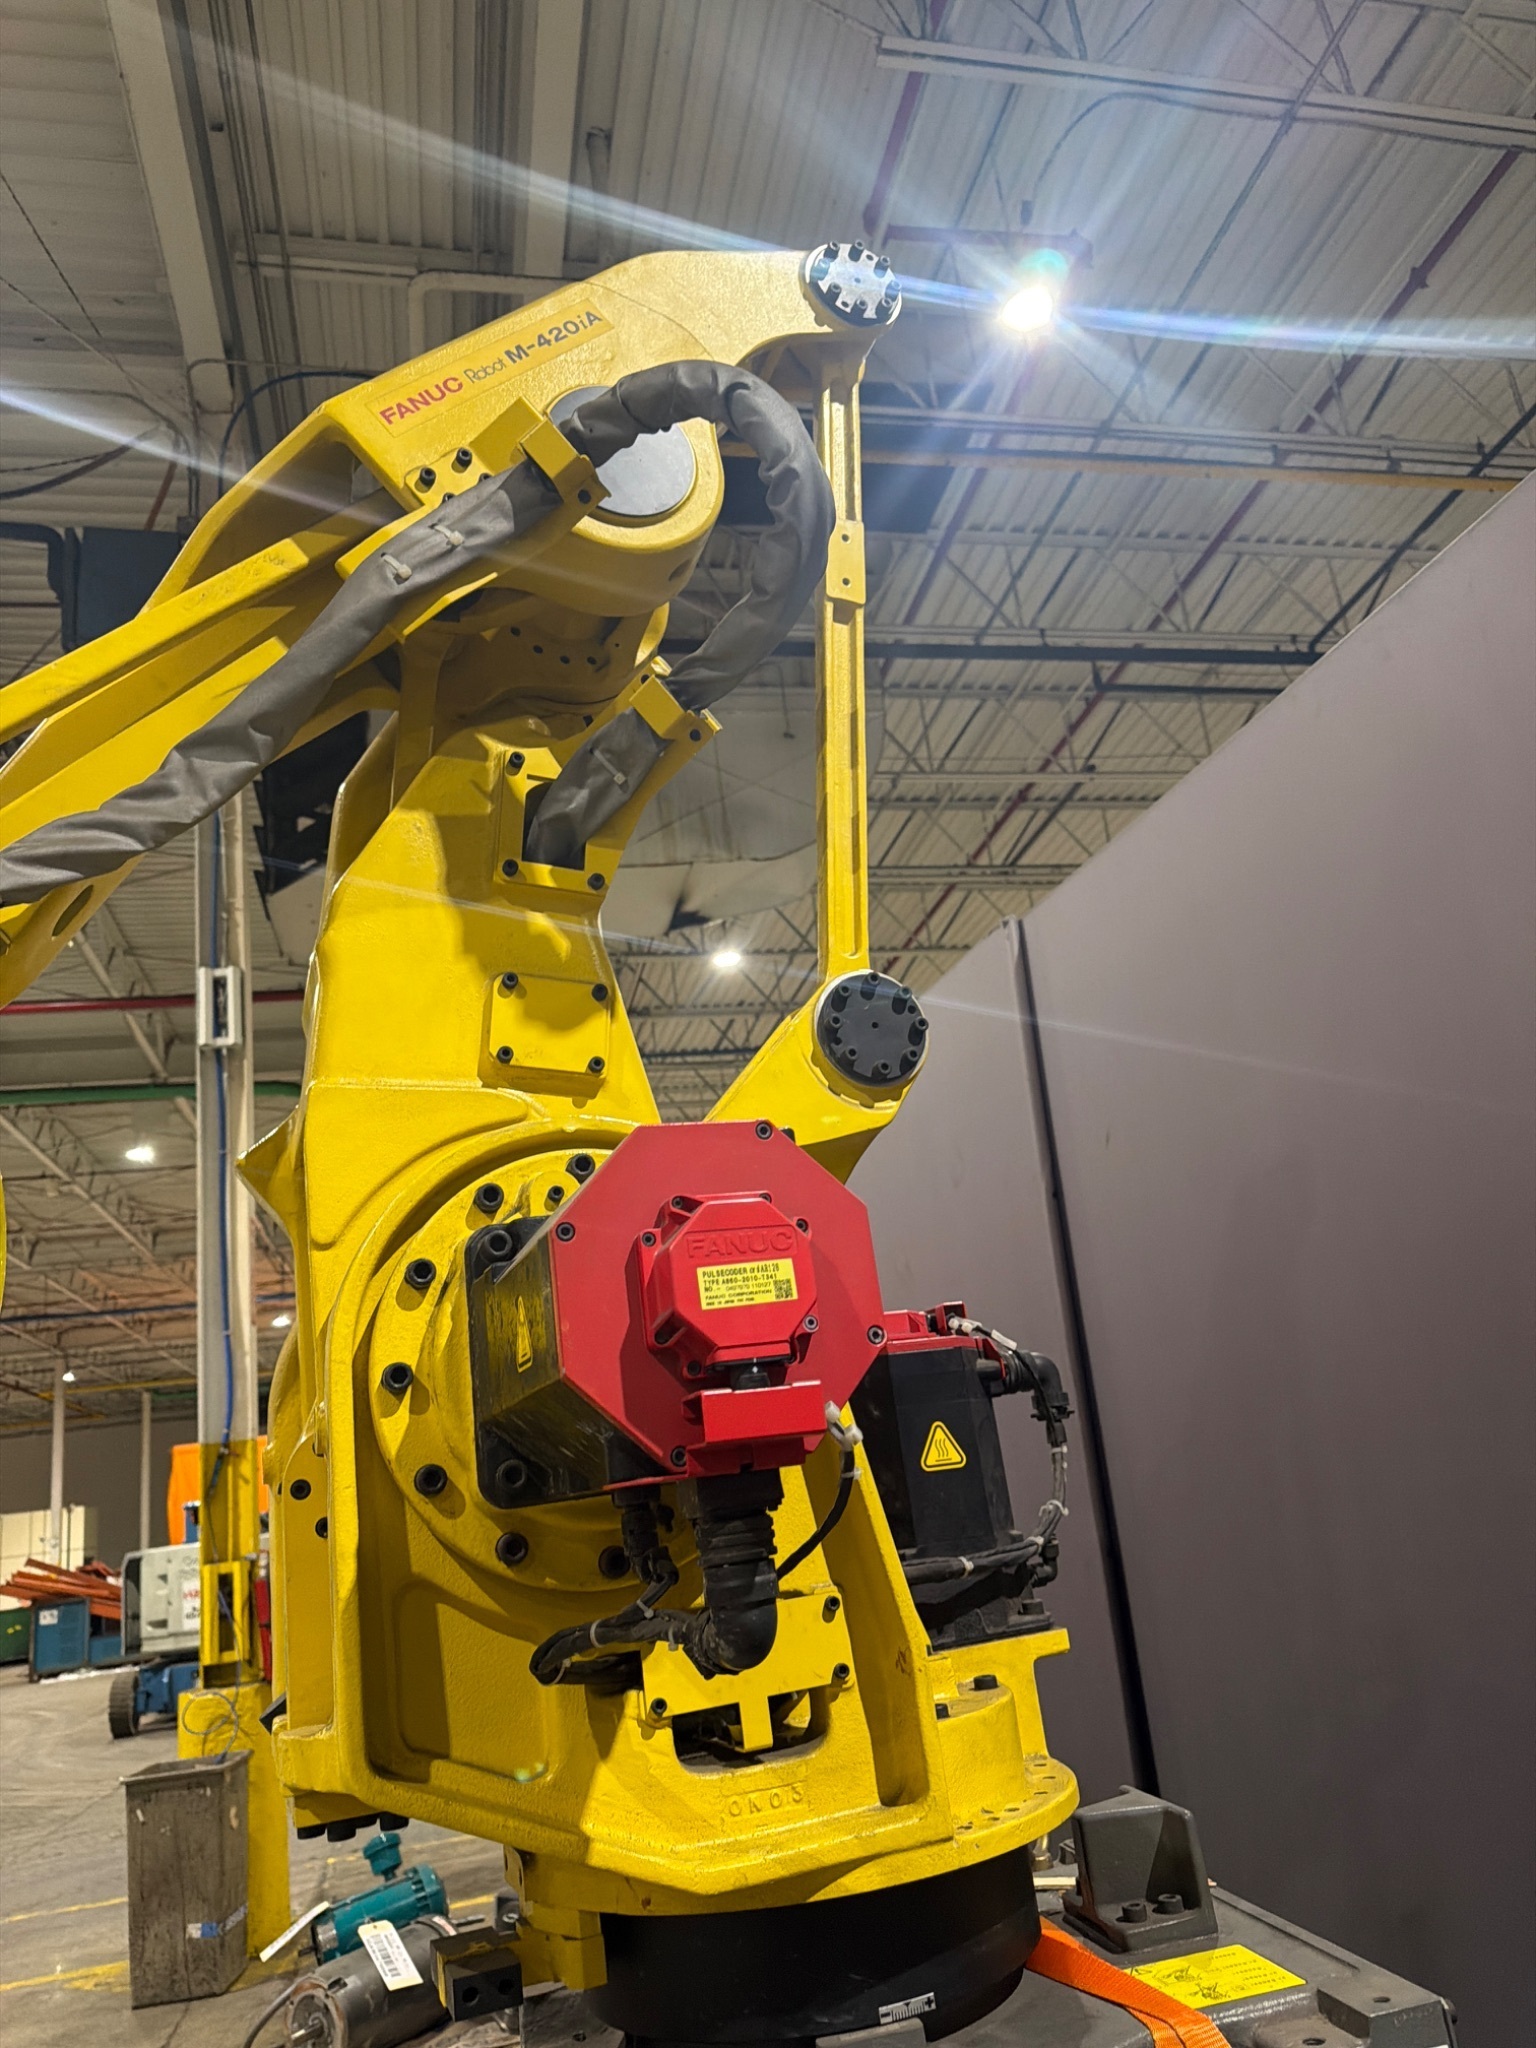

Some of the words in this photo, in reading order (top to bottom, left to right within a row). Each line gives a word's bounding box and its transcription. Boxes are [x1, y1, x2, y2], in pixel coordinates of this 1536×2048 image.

[379, 376, 463, 425] FANUC
[464, 358, 506, 383] Robot
[504, 310, 603, 364] M-420iA
[686, 1231, 793, 1258] FANUC
[702, 1266, 748, 1278] PULSECODER
[703, 1278, 720, 1287] TYPE
